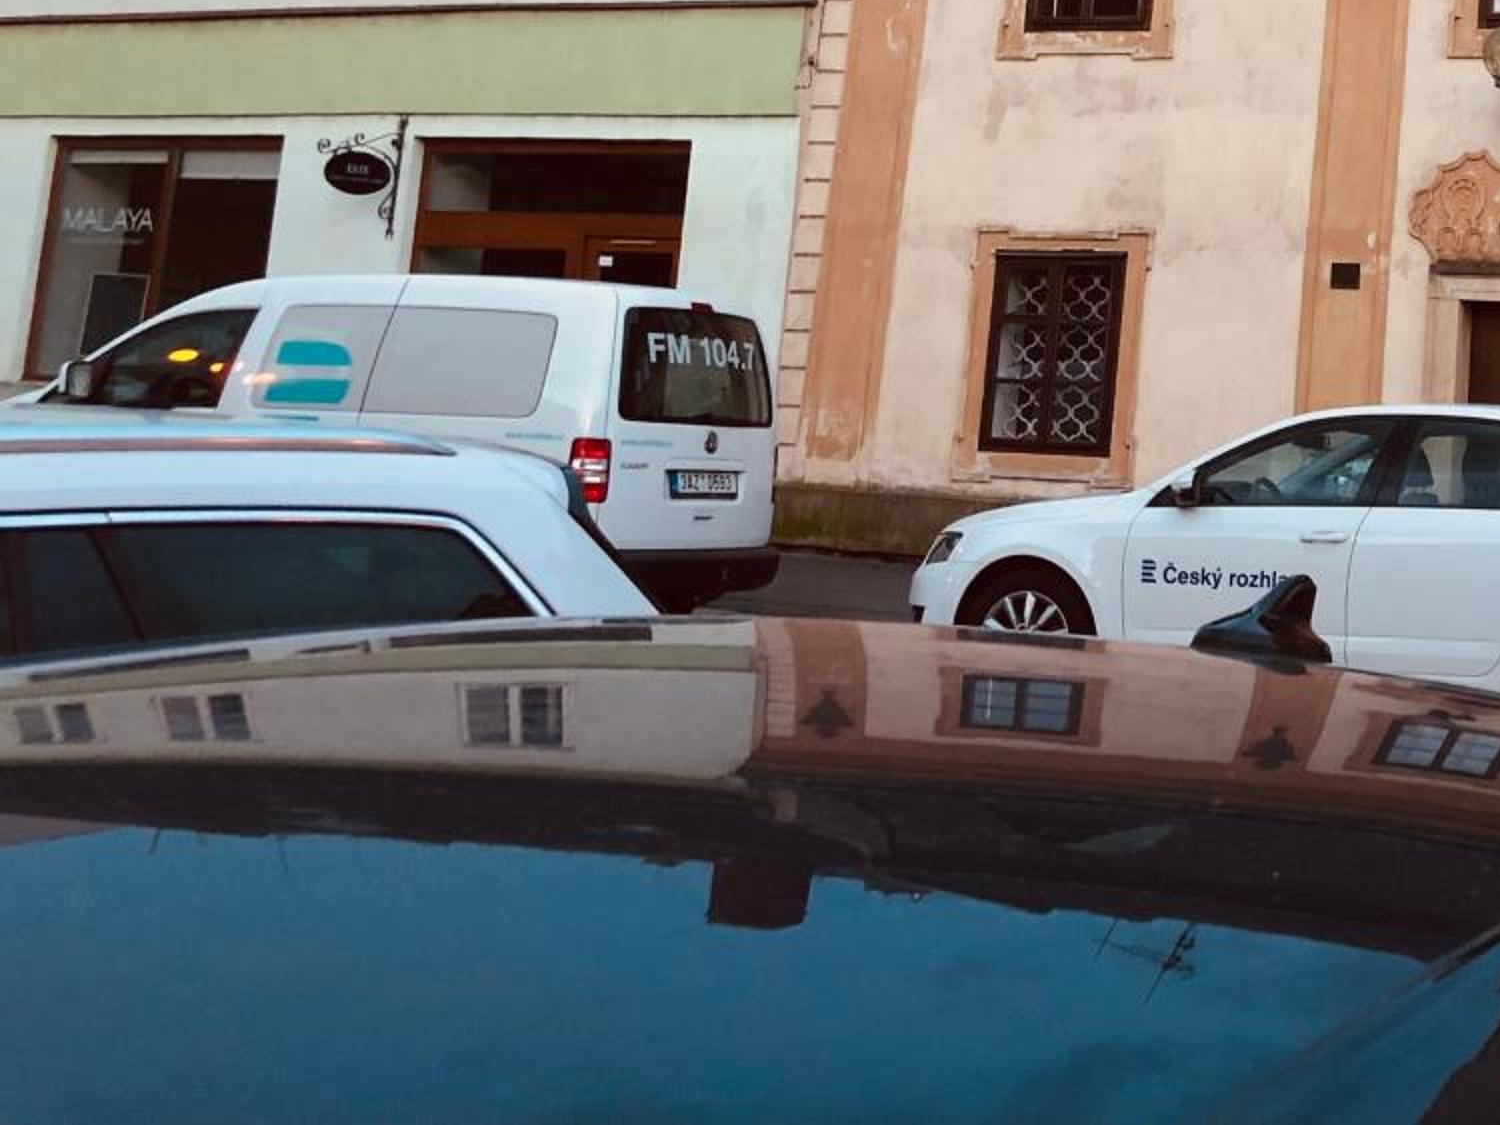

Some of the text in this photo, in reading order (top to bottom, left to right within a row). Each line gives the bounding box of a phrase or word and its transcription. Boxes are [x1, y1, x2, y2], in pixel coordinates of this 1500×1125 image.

[63, 207, 154, 232] MALAYA
[647, 332, 754, 372] FM 104.7
[1163, 562, 1222, 590] Český
